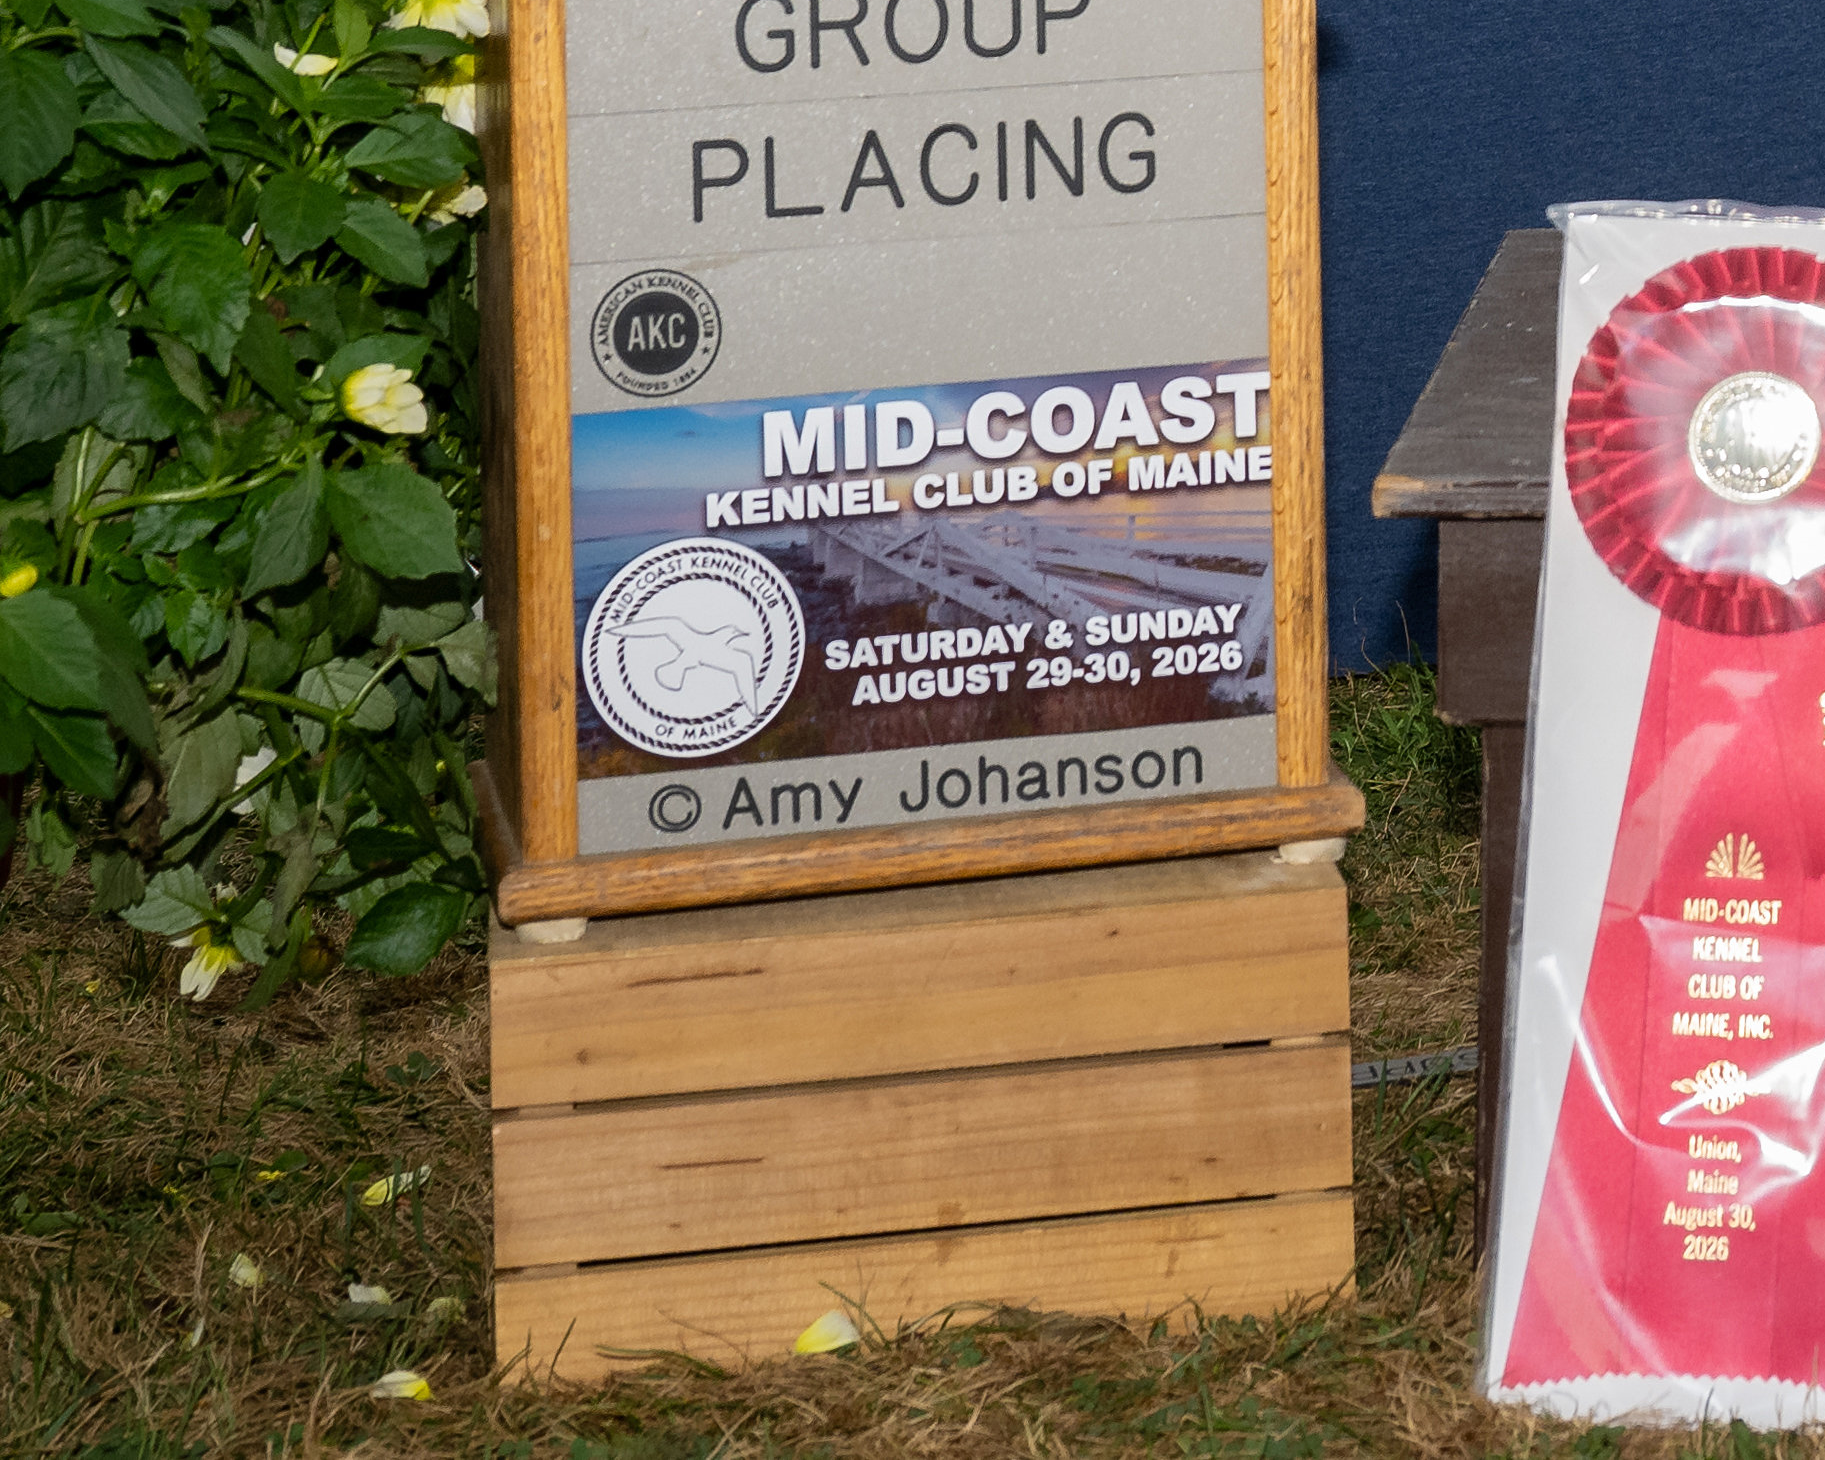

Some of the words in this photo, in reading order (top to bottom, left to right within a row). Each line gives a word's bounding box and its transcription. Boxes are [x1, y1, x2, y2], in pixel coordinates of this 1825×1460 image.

[692, 111, 1157, 223] PLACING
[627, 312, 687, 352] AKC
[698, 302, 715, 338] CLUB
[762, 371, 1270, 478] MID-COAST
[705, 478, 900, 528] KENNEL
[912, 464, 1038, 511] CLUB
[1052, 458, 1114, 499] OF
[1128, 445, 1273, 491] MAINE
[609, 559, 683, 623] MID-COAST
[690, 556, 747, 581] KENNEL
[750, 575, 780, 610] CLUB
[825, 622, 1032, 672] SATURDAY
[1044, 618, 1074, 651] &
[1085, 603, 1243, 648] SUNDAY
[852, 662, 1016, 706] AUGUST
[1027, 650, 1142, 688] 29-30,
[1153, 639, 1243, 677] 2026
[655, 723, 674, 738] OF
[683, 716, 738, 740] MAINE
[722, 777, 863, 830] Amy
[900, 744, 1204, 812] Johanson
[1682, 897, 1782, 925] MID-COAST
[1692, 935, 1763, 963] KENNEL
[1687, 973, 1736, 999] CLUB
[1739, 974, 1766, 1000] OF
[1672, 1011, 1734, 1041] MAINE,
[1738, 1013, 1774, 1040] INC.
[1688, 1133, 1742, 1163] Union,
[1686, 1168, 1739, 1195] Maine
[1663, 1200, 1724, 1231] August
[1728, 1202, 1757, 1232] 30,
[1682, 1234, 1729, 1261] 2026
